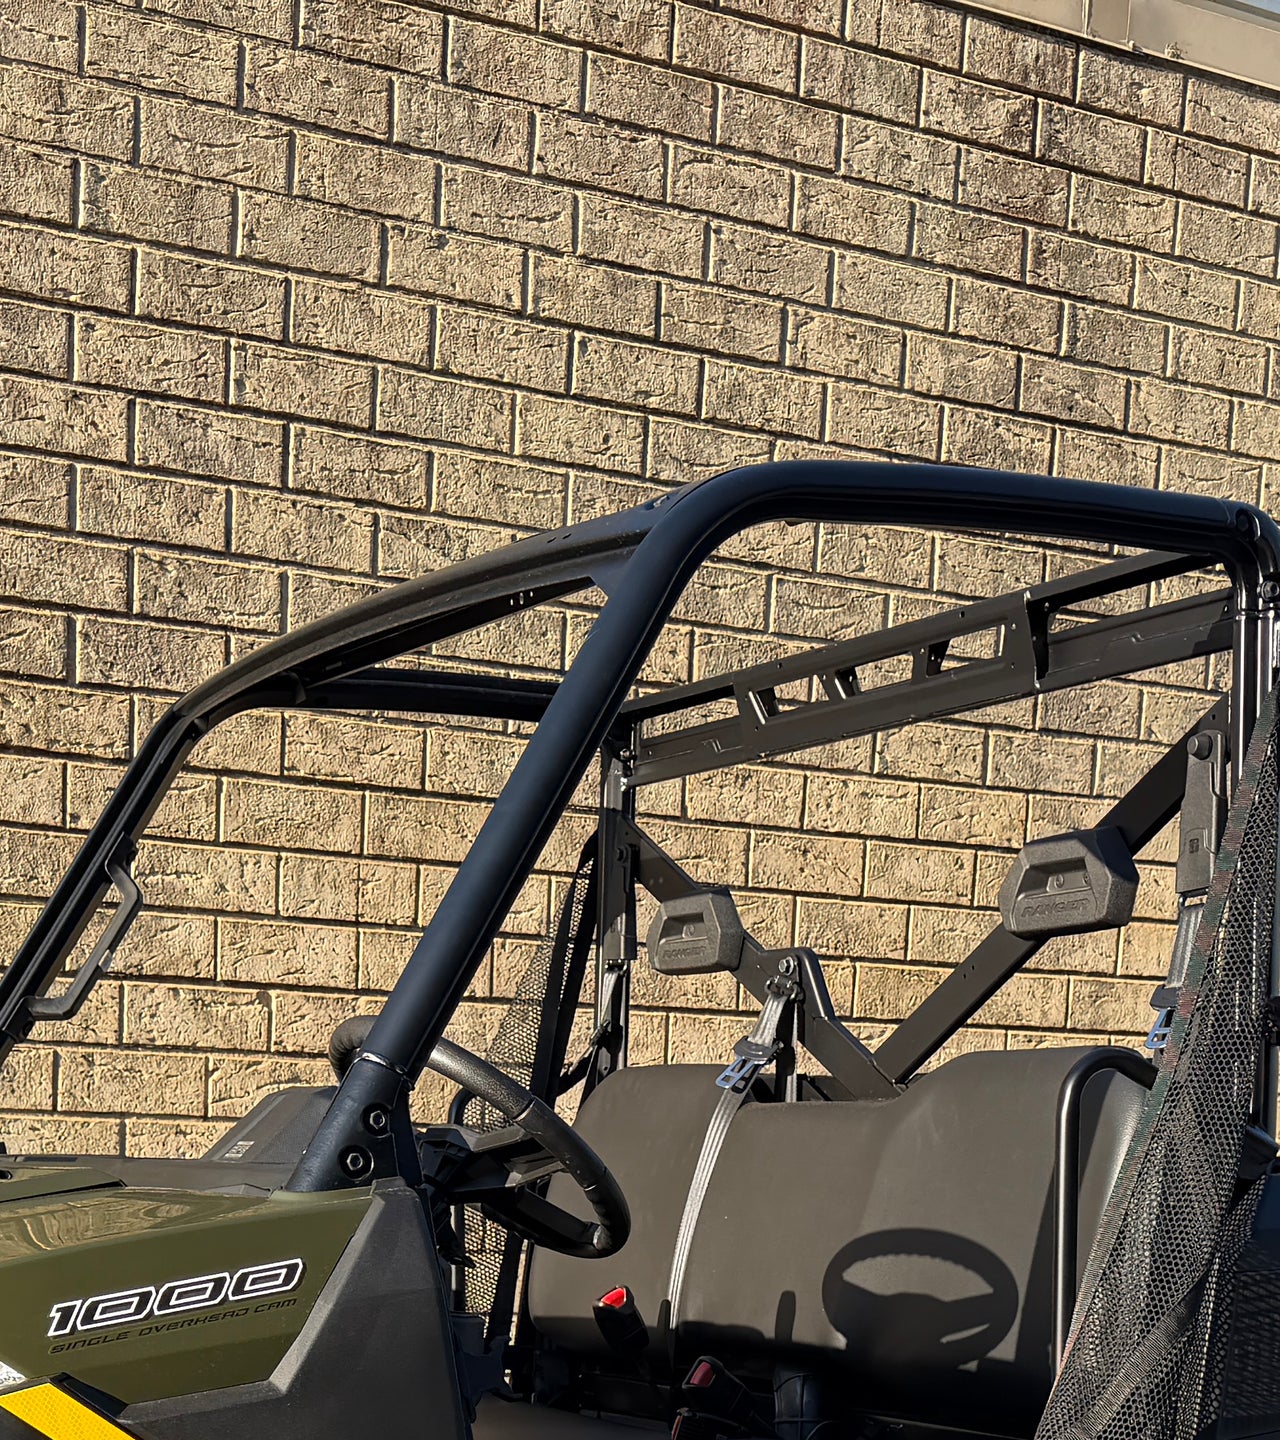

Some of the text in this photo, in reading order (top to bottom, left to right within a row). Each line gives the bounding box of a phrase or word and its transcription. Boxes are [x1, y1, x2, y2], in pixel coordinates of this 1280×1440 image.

[1021, 897, 1090, 918] RANGER
[47, 1258, 305, 1339] 1000
[50, 1298, 298, 1354] SINGLE OVERHEAD CAM
